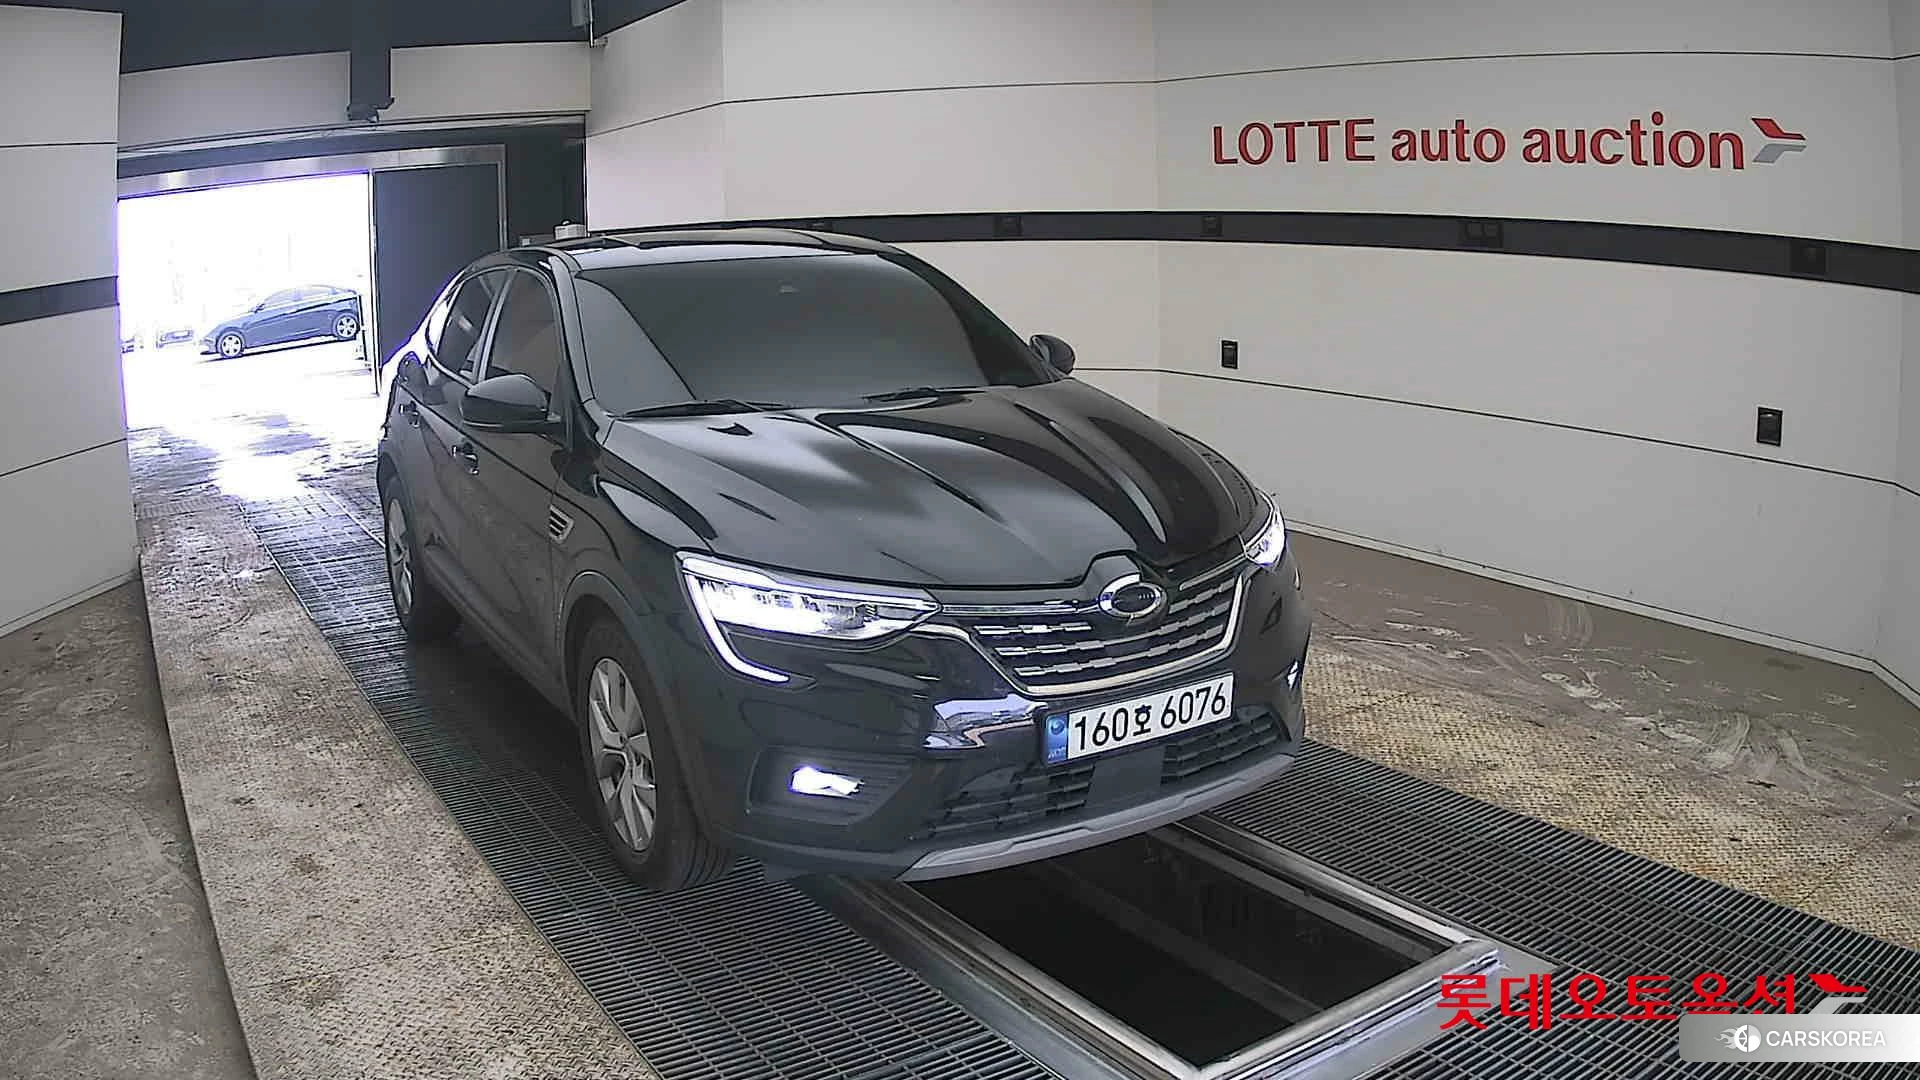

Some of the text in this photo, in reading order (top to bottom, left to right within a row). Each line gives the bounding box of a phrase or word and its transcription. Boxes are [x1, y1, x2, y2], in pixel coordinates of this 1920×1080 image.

[1212, 112, 1744, 169] LOTTE auto auction
[1074, 682, 1226, 751] 160호 6076
